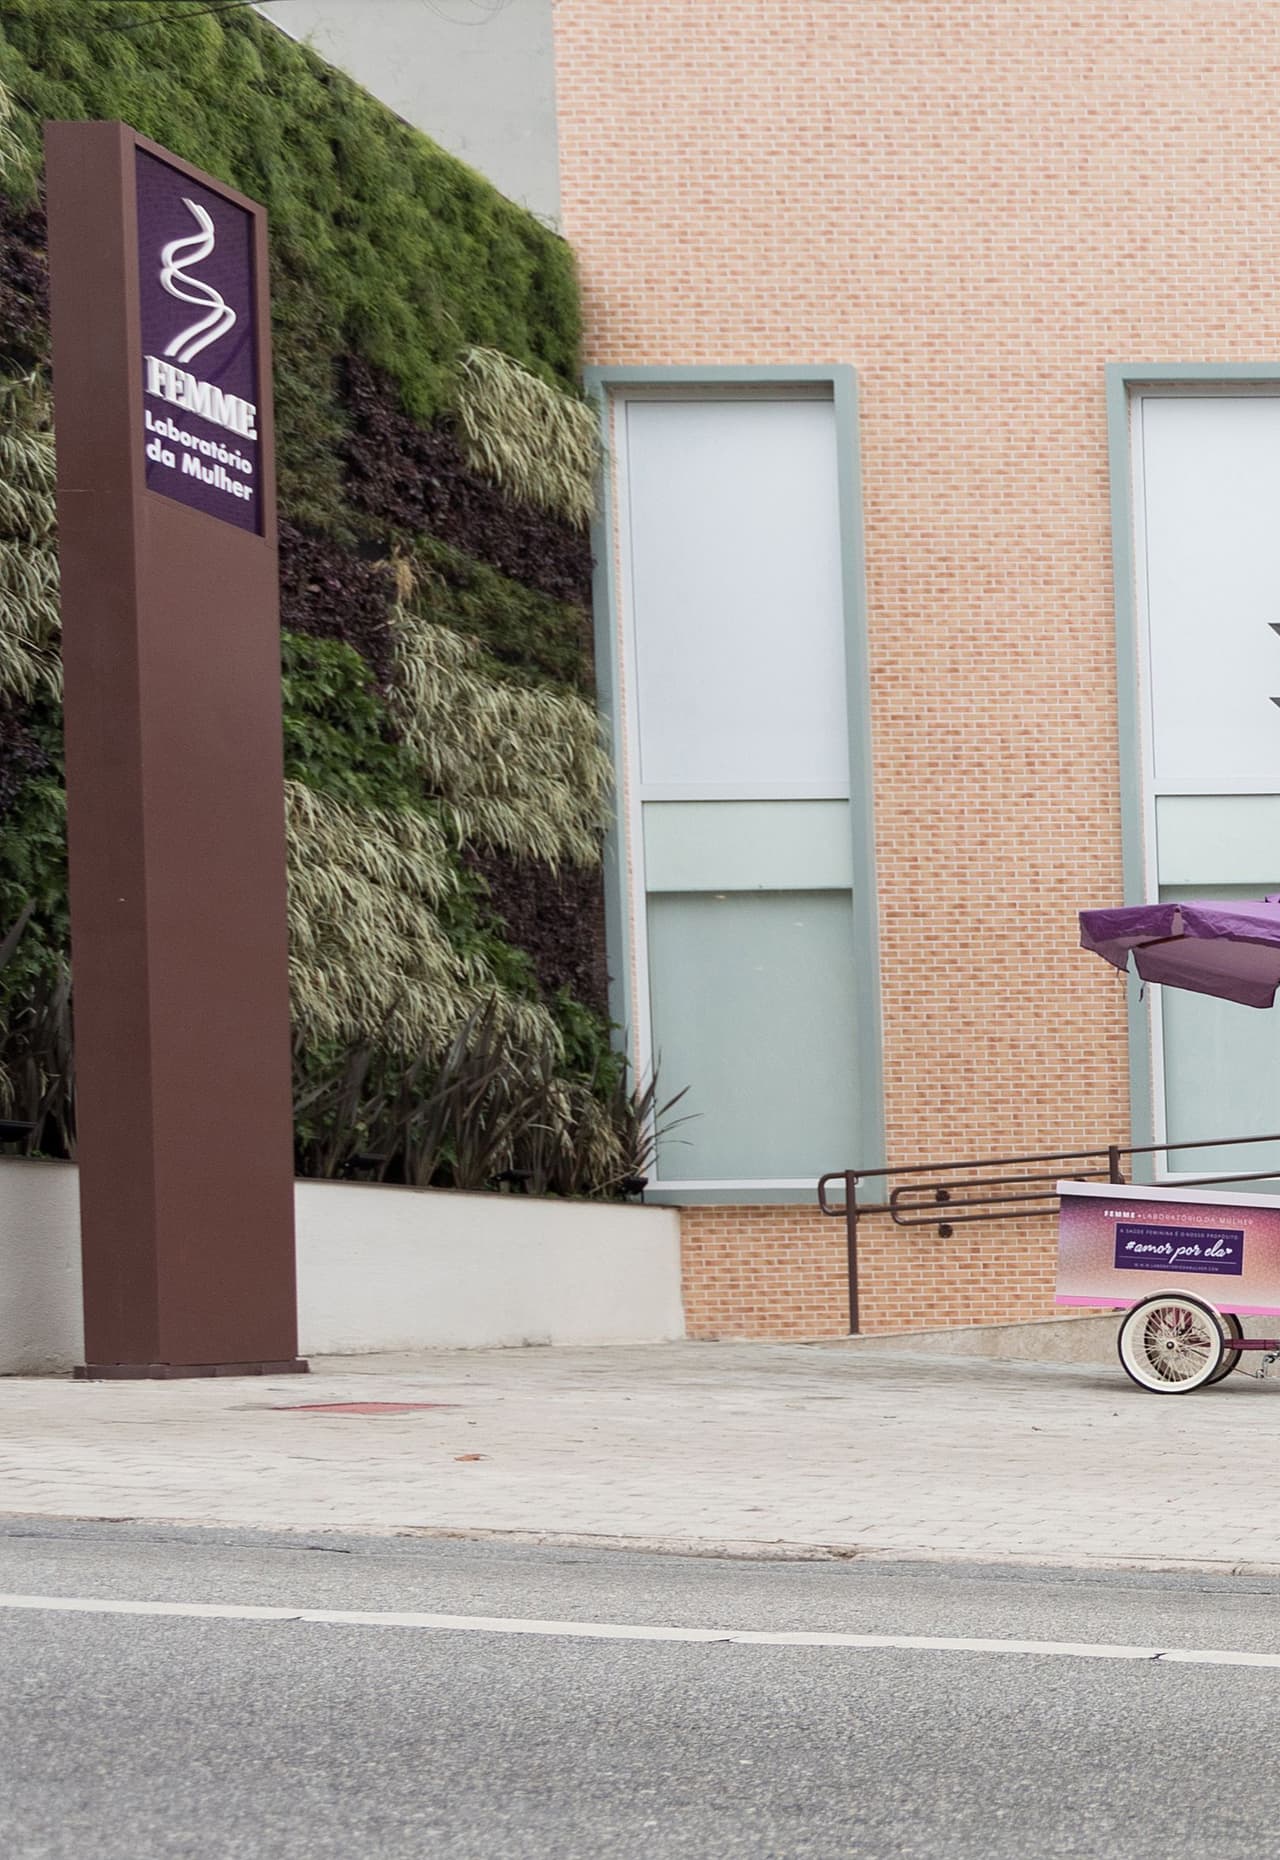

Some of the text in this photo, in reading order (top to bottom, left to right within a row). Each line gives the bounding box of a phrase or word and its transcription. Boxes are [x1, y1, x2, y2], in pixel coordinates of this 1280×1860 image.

[144, 355, 257, 440] FEMME
[145, 410, 253, 474] Laboratório
[146, 438, 253, 501] da Mulher
[1104, 1210, 1136, 1219] FEMME
[1125, 1239, 1227, 1265] #amor por ela
